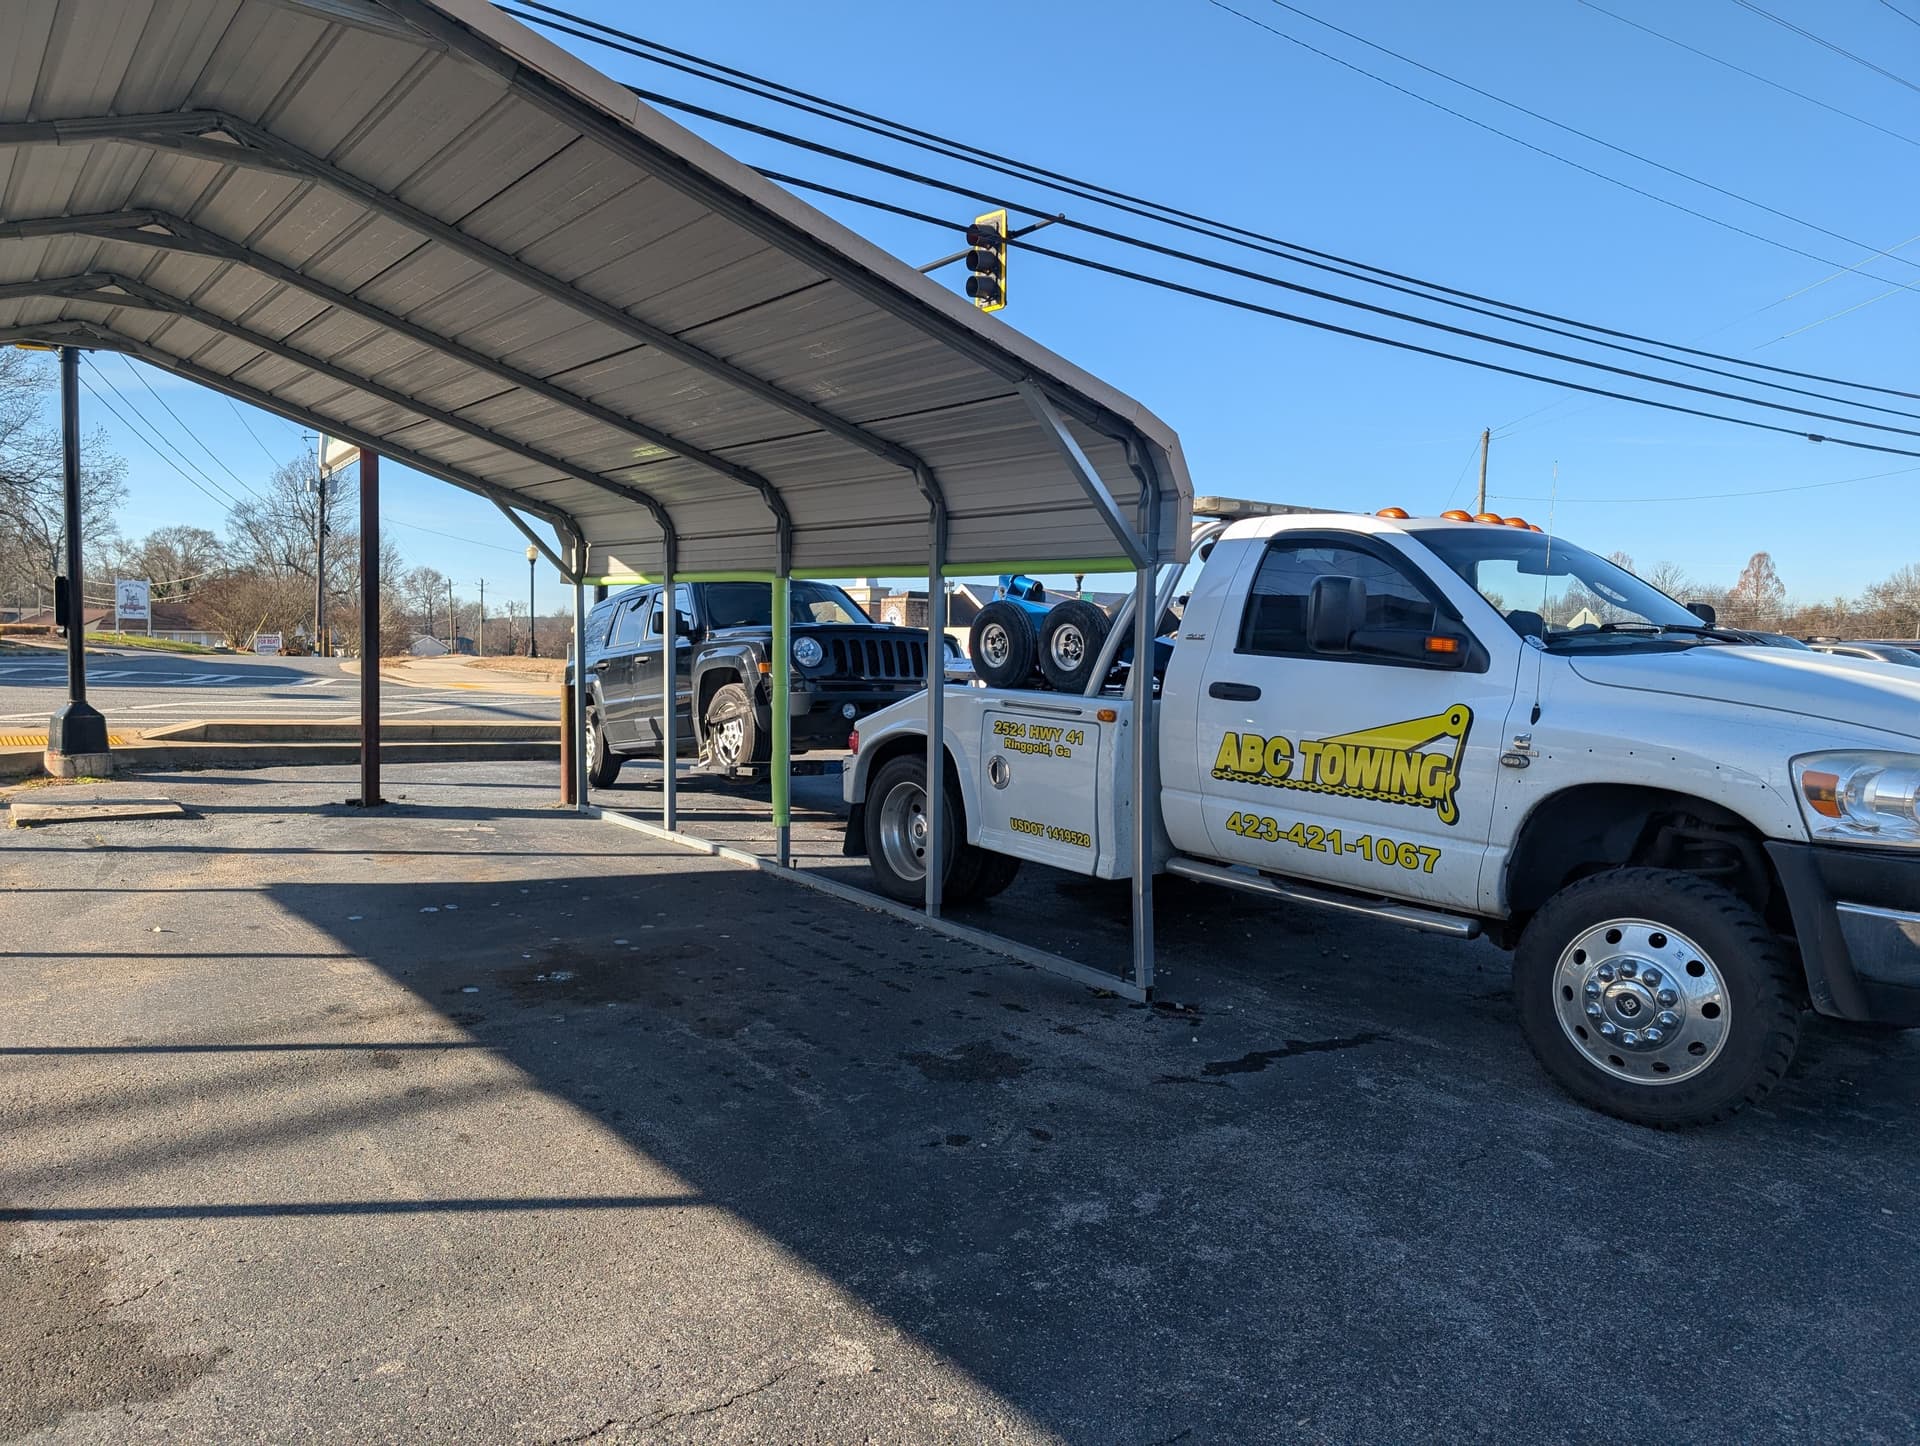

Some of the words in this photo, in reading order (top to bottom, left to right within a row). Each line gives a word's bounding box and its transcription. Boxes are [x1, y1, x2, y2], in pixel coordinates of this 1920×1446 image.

[993, 720, 1026, 737] 2524
[1029, 725, 1064, 742] HWY
[1066, 730, 1084, 745] 41
[1004, 737, 1053, 757] Ringgold,
[1055, 745, 1071, 758] Ga
[1214, 731, 1294, 780] ABC
[1299, 740, 1448, 799] TOWING
[1010, 817, 1044, 836] USDOT
[1047, 826, 1090, 848] 1419528
[1225, 811, 1441, 874] 423-421-1067
